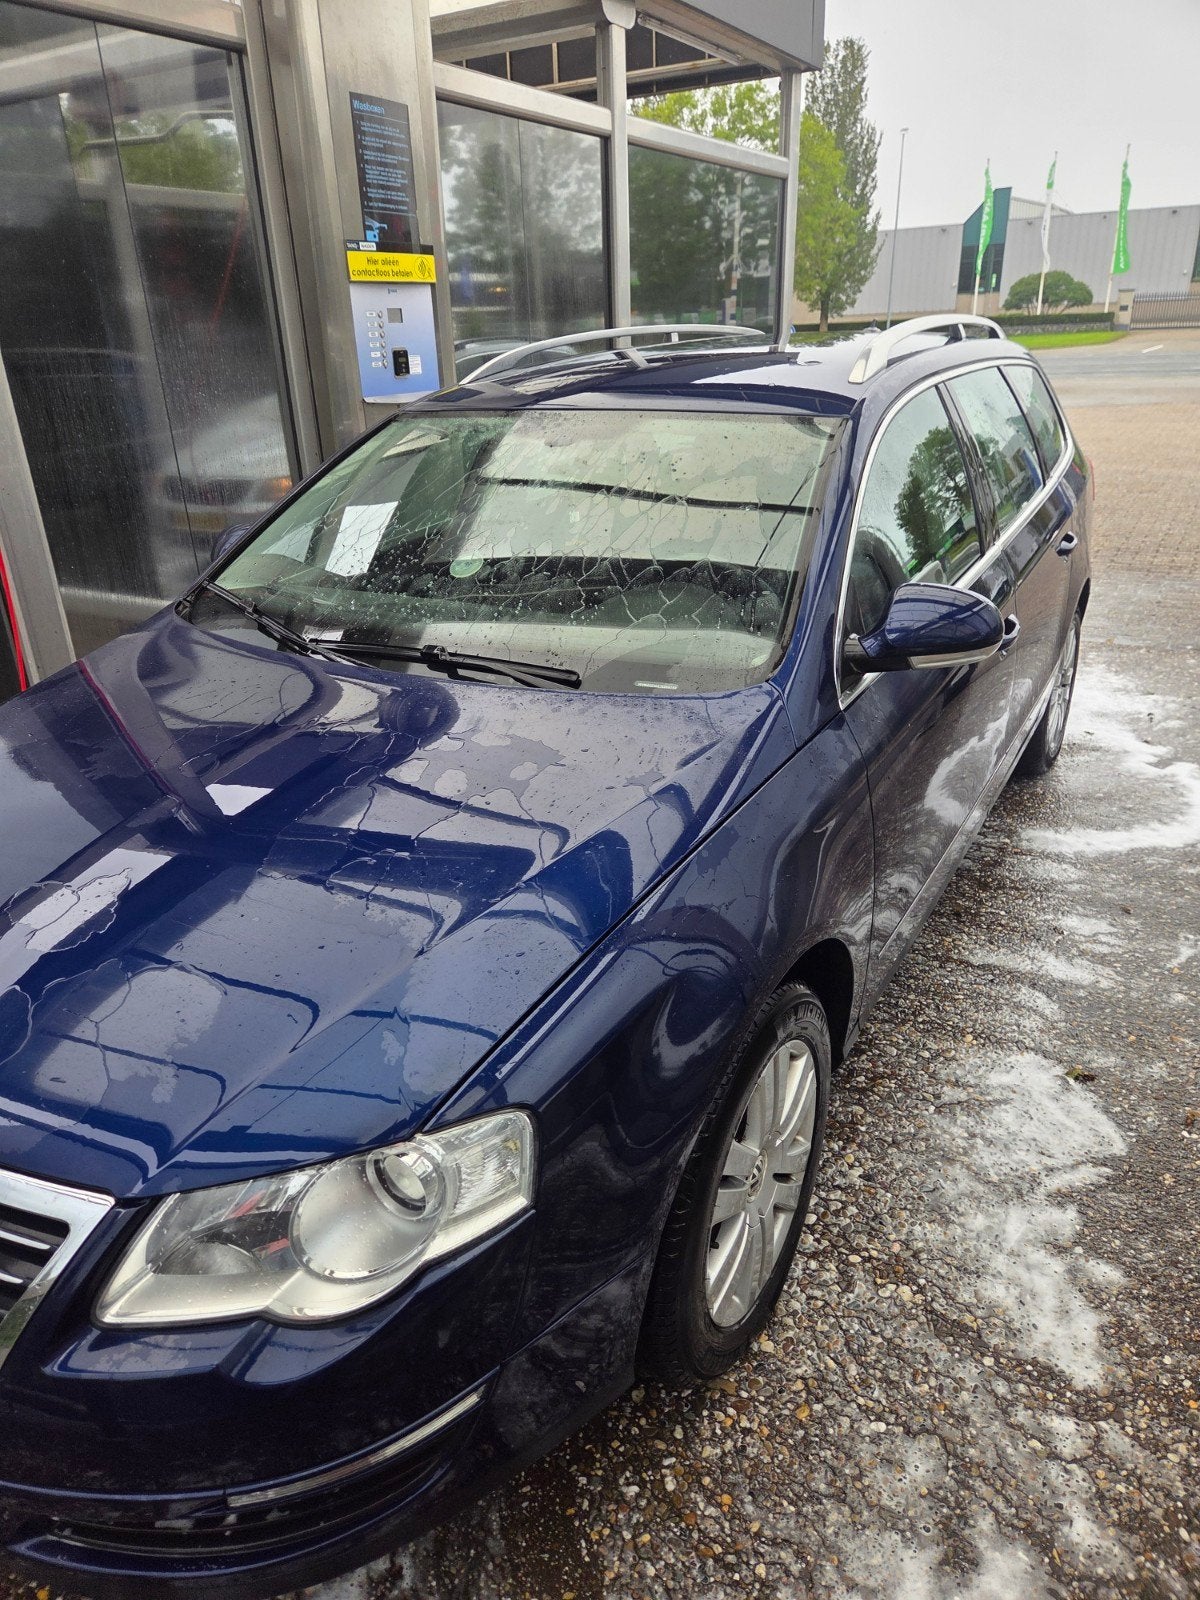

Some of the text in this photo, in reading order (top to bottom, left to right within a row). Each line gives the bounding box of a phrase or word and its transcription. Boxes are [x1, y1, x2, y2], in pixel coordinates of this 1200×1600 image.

[367, 257, 379, 266] Hier
[352, 268, 413, 278] contactloos betalen
